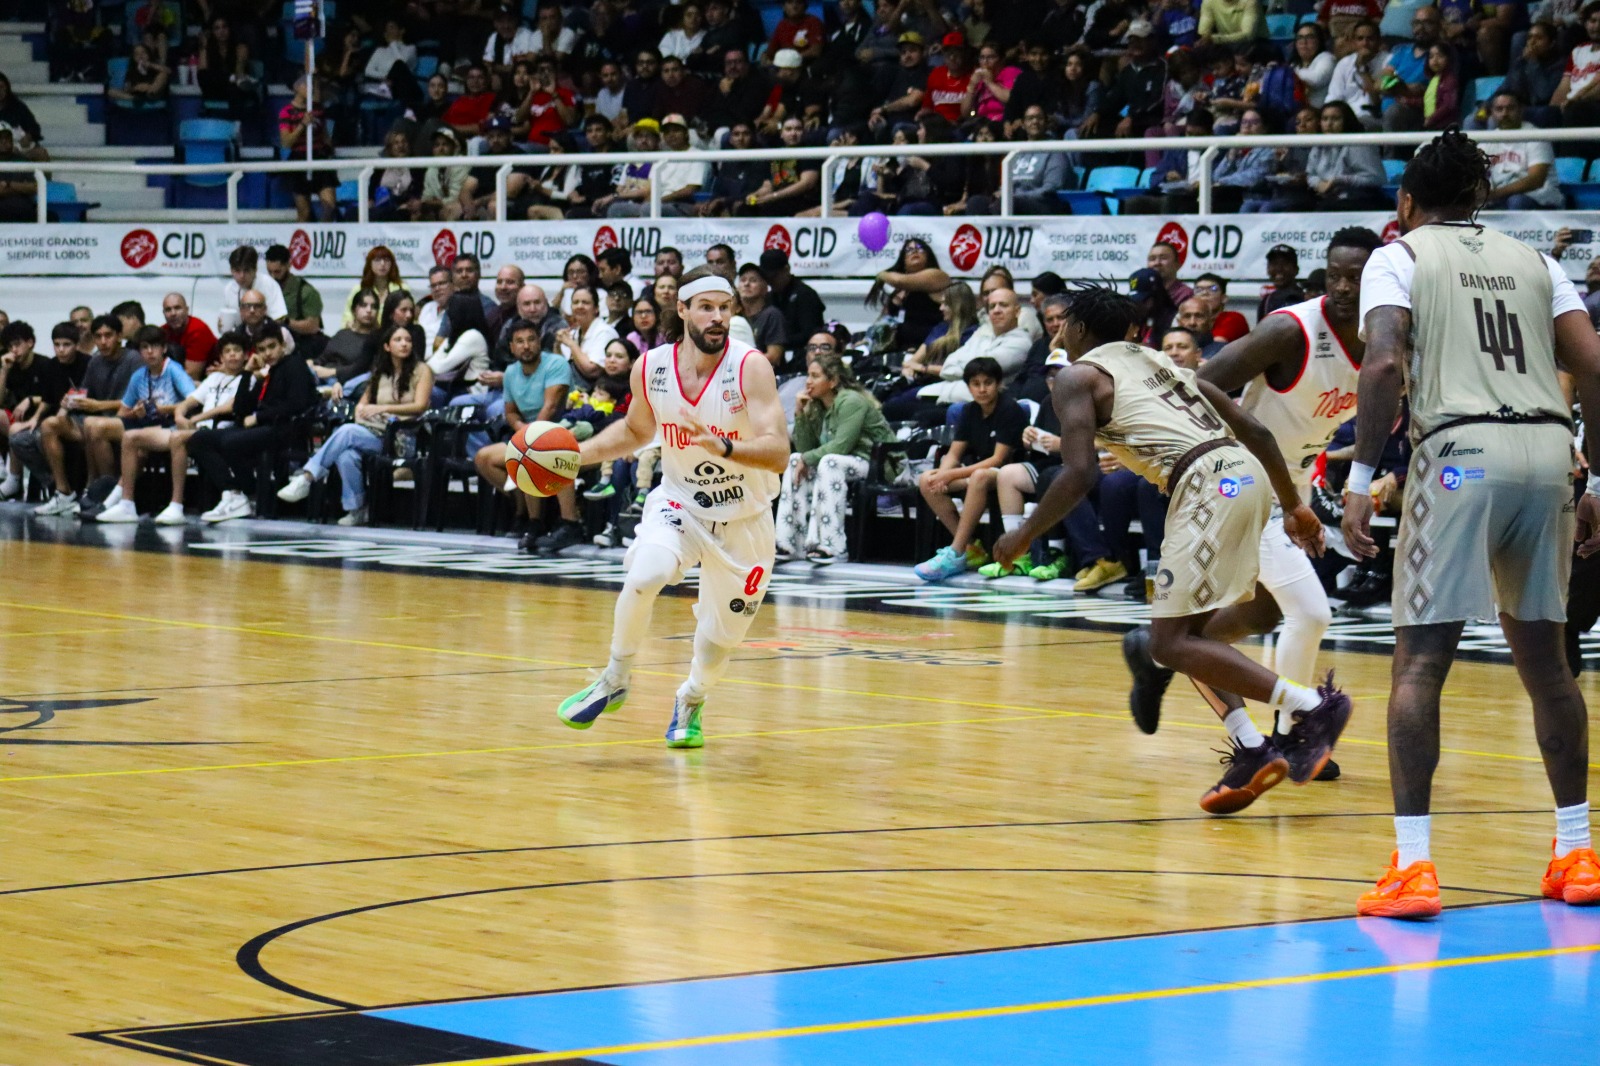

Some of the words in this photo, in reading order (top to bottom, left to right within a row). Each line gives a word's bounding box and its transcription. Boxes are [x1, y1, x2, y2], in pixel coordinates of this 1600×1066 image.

[46, 236, 99, 248] GRANDES
[162, 231, 206, 259] CID
[313, 231, 347, 260] UAD
[460, 231, 495, 260] CID
[508, 235, 541, 247] SIEMPRE
[542, 235, 578, 246] GRANDES
[621, 226, 661, 258] UAD
[794, 226, 837, 258] CID
[984, 226, 1034, 259] UAD
[1048, 234, 1088, 245] SIEMPRE
[1089, 233, 1137, 245] GRANDES
[1192, 224, 1243, 259] CID
[1261, 231, 1307, 243] SIEMPRE
[7, 250, 52, 261] SIEMPRE
[54, 250, 91, 261] LOBOS
[513, 250, 545, 261] SIEMPRE
[1052, 250, 1094, 261] SIEMPRE
[1096, 250, 1129, 261] LOBOS
[1459, 272, 1517, 291] BANYARD
[1473, 297, 1527, 375] 44
[1158, 380, 1224, 432] 55
[1451, 447, 1485, 457] cemex
[1223, 460, 1245, 470] cemex
[1221, 482, 1240, 496] BJ
[1443, 472, 1461, 489] BJ
[712, 485, 744, 504] UAD
